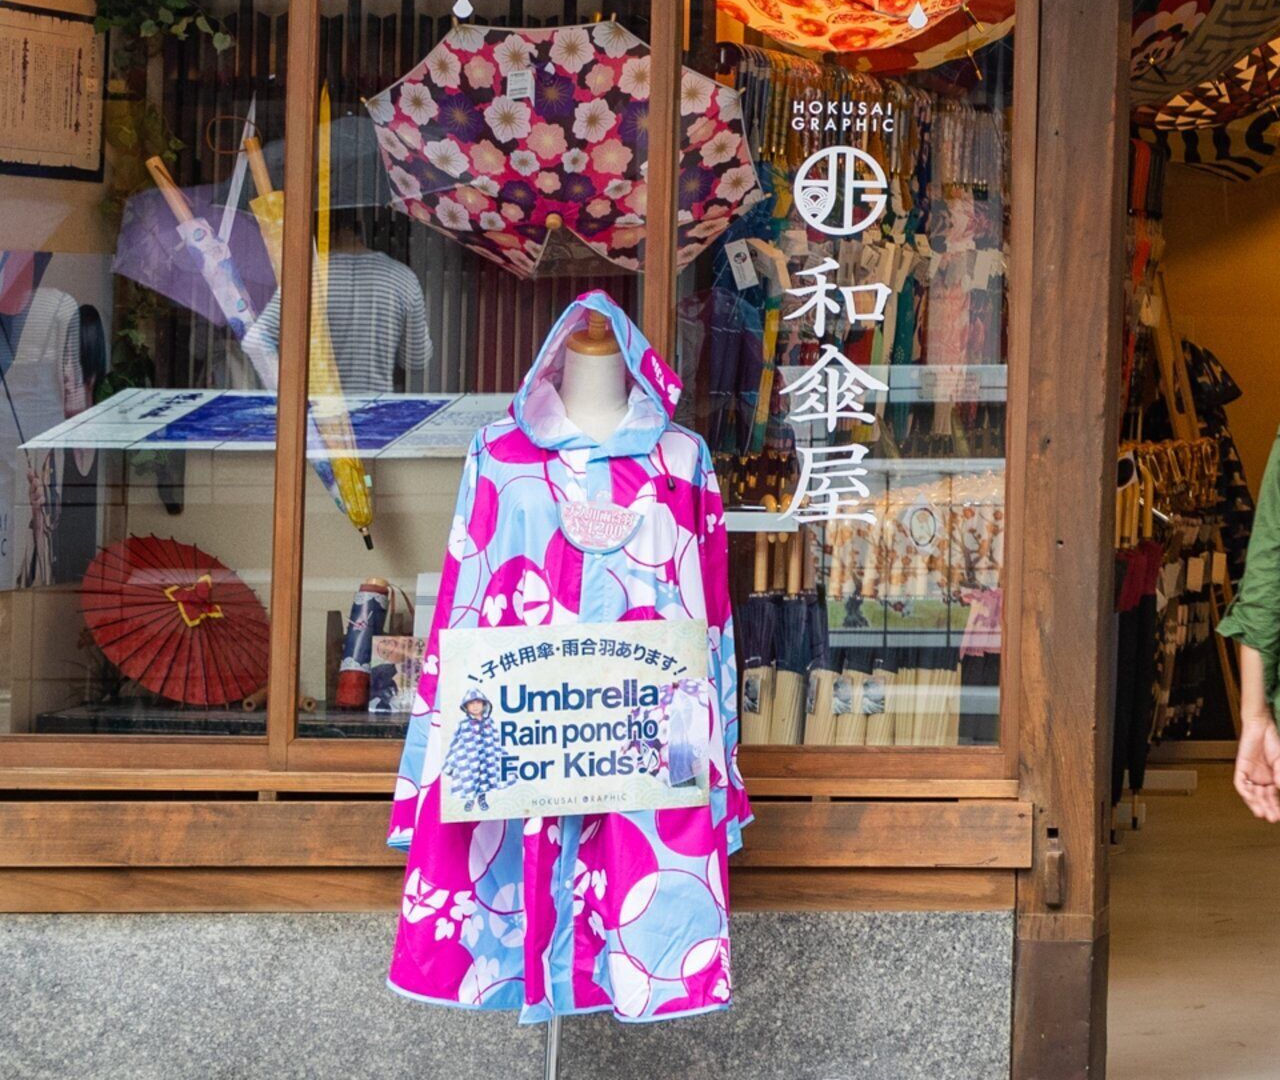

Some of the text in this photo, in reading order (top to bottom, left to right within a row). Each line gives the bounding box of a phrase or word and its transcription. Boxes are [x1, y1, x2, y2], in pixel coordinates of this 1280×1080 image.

[792, 100, 893, 116] HOKUSAI
[790, 117, 895, 133] GRAPHIC
[777, 256, 893, 525] 和傘屋
[499, 678, 660, 714] Umbrella
[500, 715, 659, 751] Rain poncho
[500, 751, 634, 782] For Kids
[531, 792, 628, 807] HOKUSAI GRAPHIC
